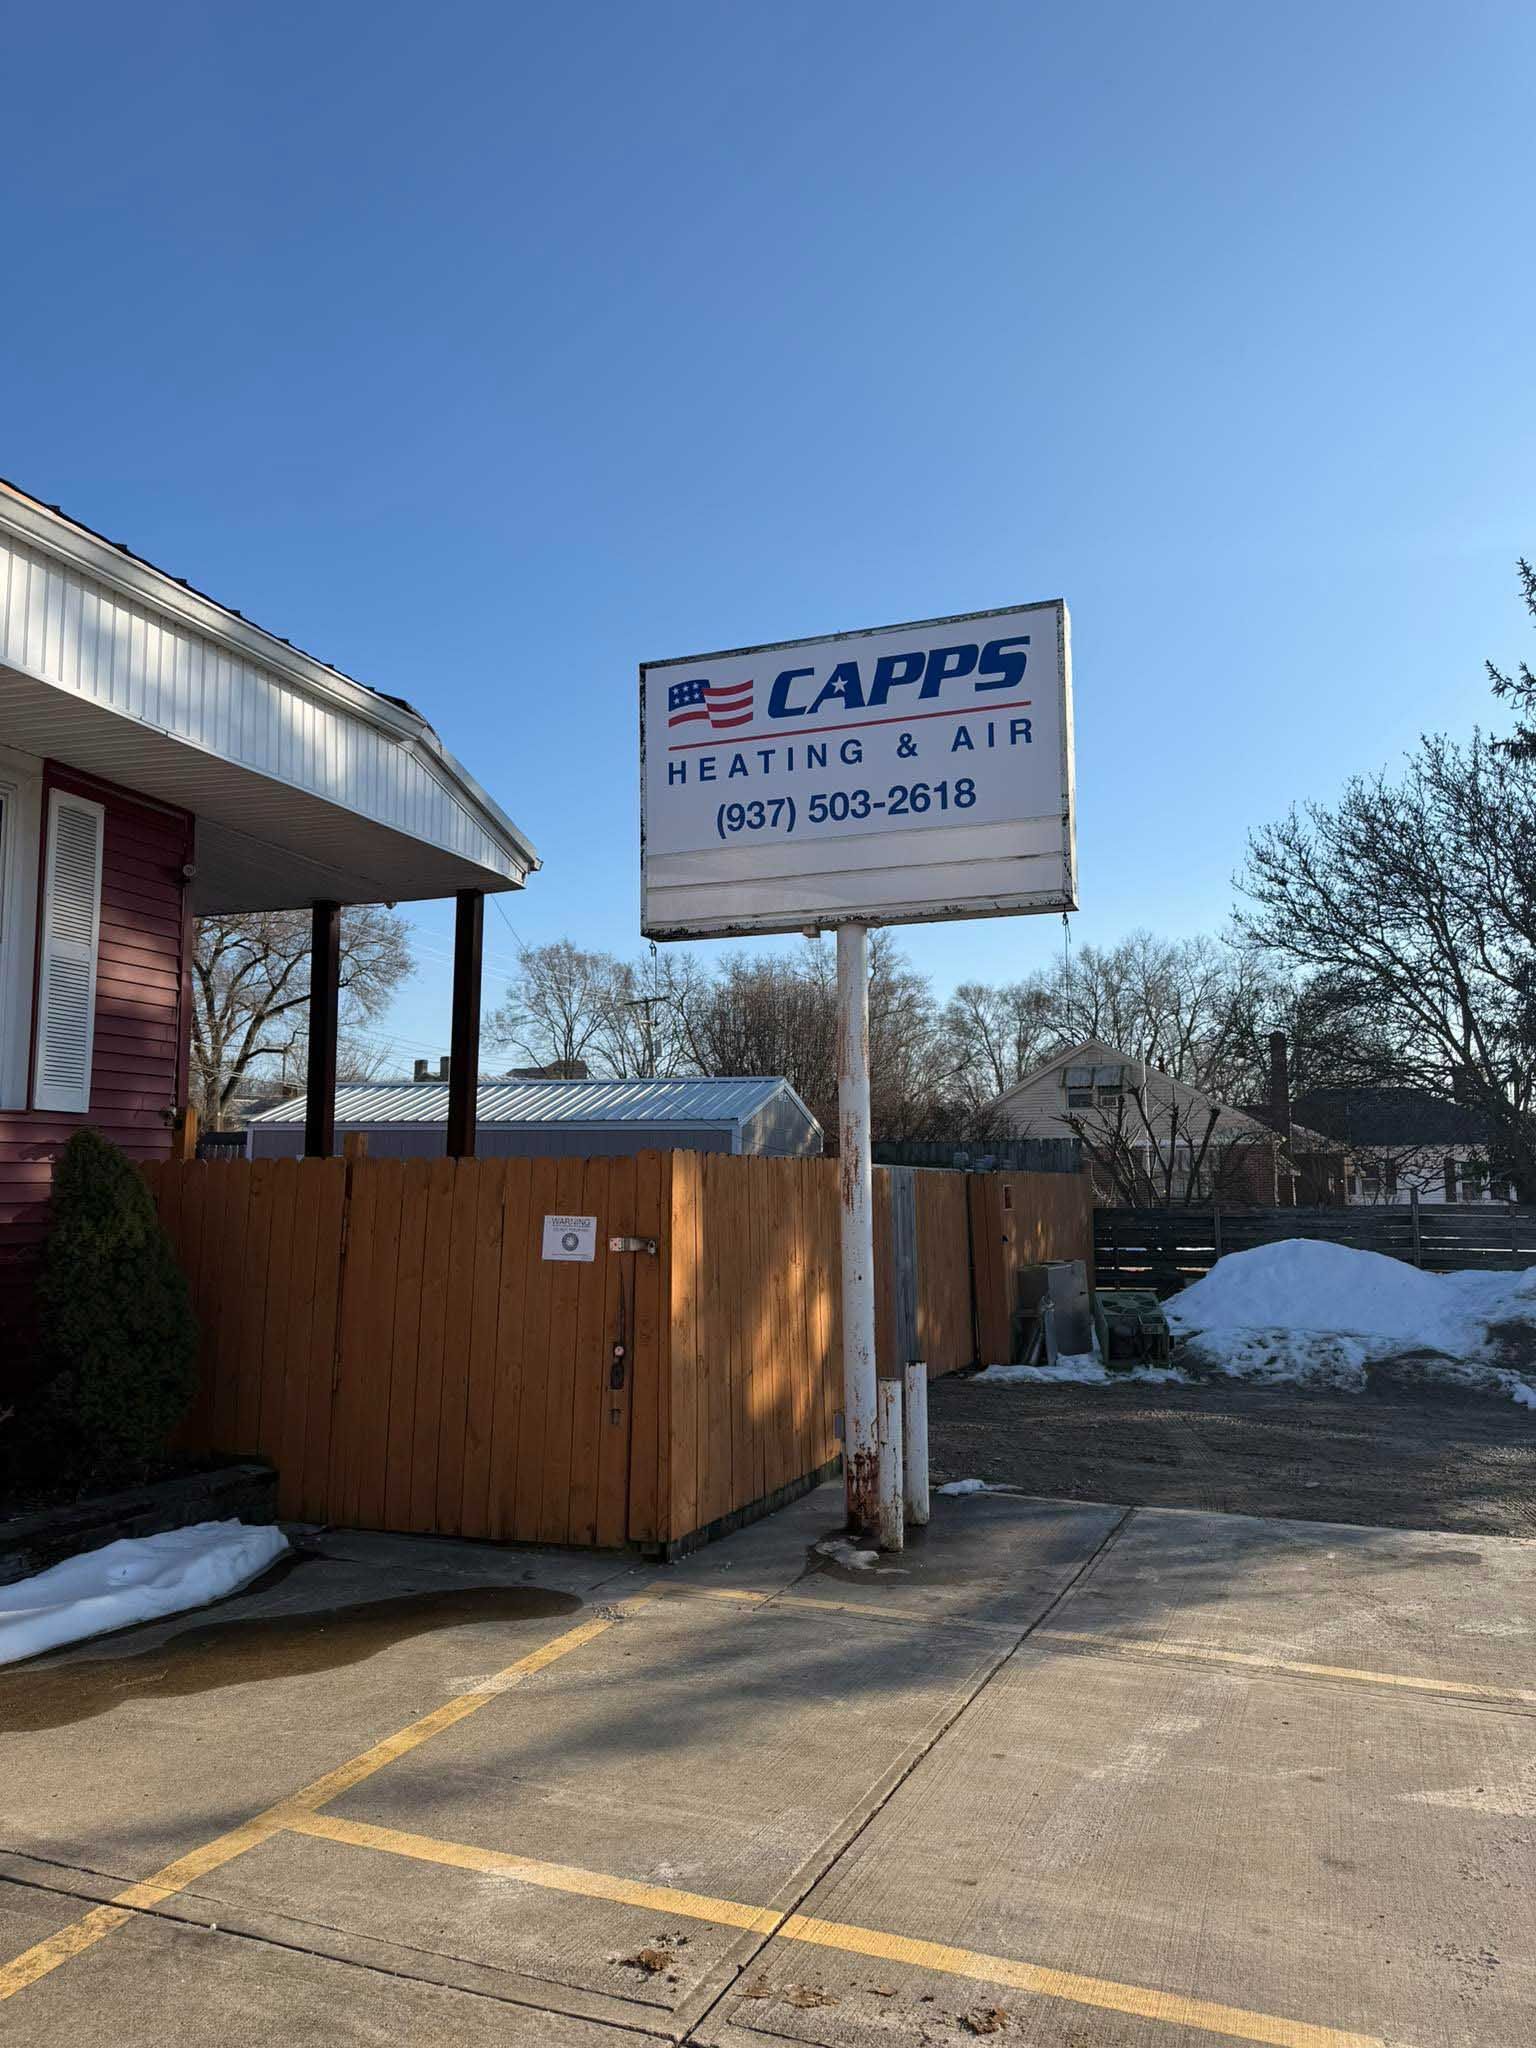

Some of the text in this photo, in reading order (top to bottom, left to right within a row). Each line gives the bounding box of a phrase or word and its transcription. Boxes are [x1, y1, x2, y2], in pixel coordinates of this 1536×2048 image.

[767, 635, 1031, 719] CAPPS
[667, 718, 1033, 787] HEATING & AIR
[716, 777, 977, 841] (937) 503-2618
[551, 1217, 591, 1226] WARNING
